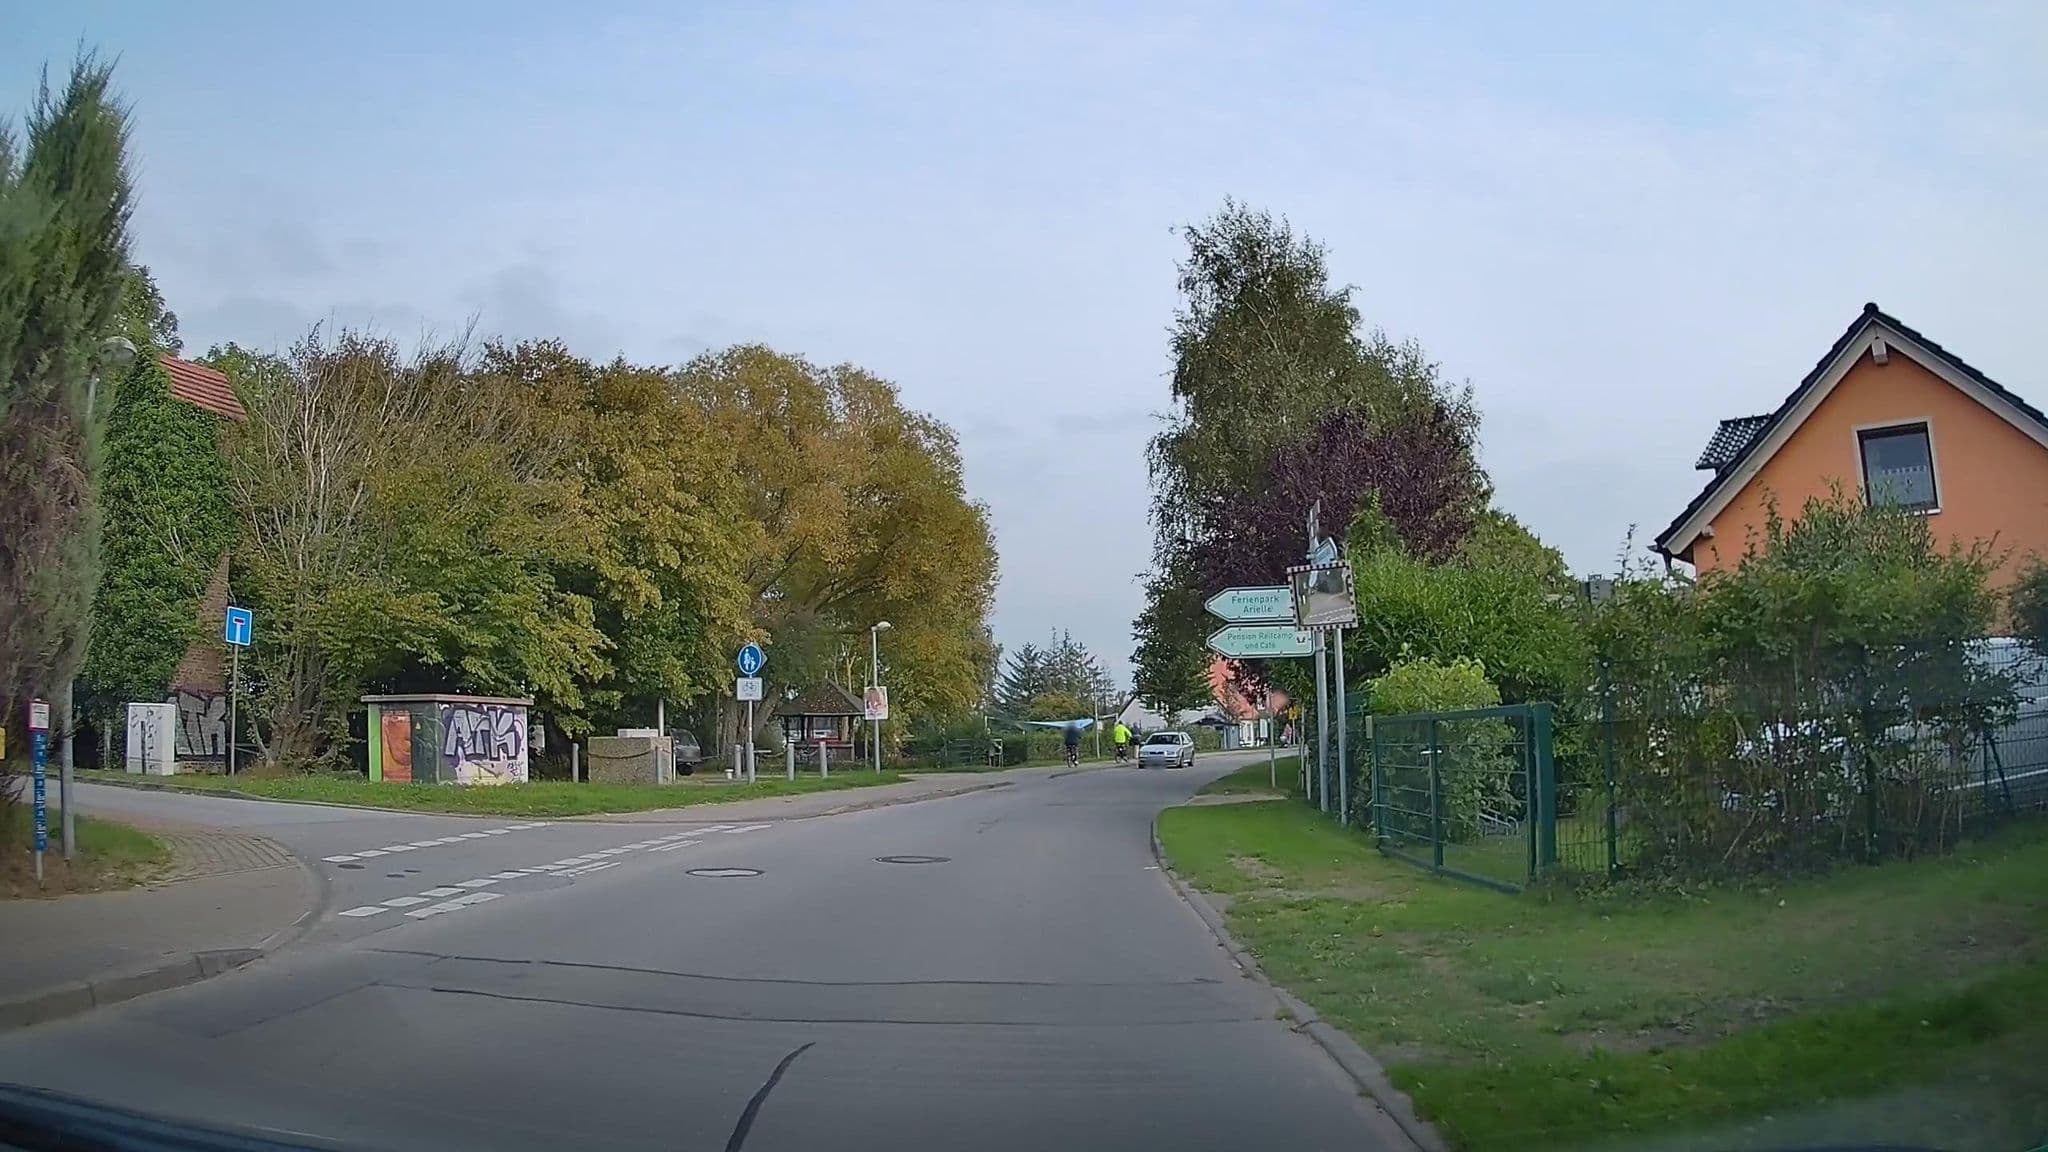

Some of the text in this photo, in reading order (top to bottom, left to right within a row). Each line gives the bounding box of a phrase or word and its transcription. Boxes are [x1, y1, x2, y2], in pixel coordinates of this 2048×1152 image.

[1231, 595, 1280, 604] Ferienpark
[1243, 605, 1273, 613] Arielle
[1227, 633, 1257, 641] Pension
